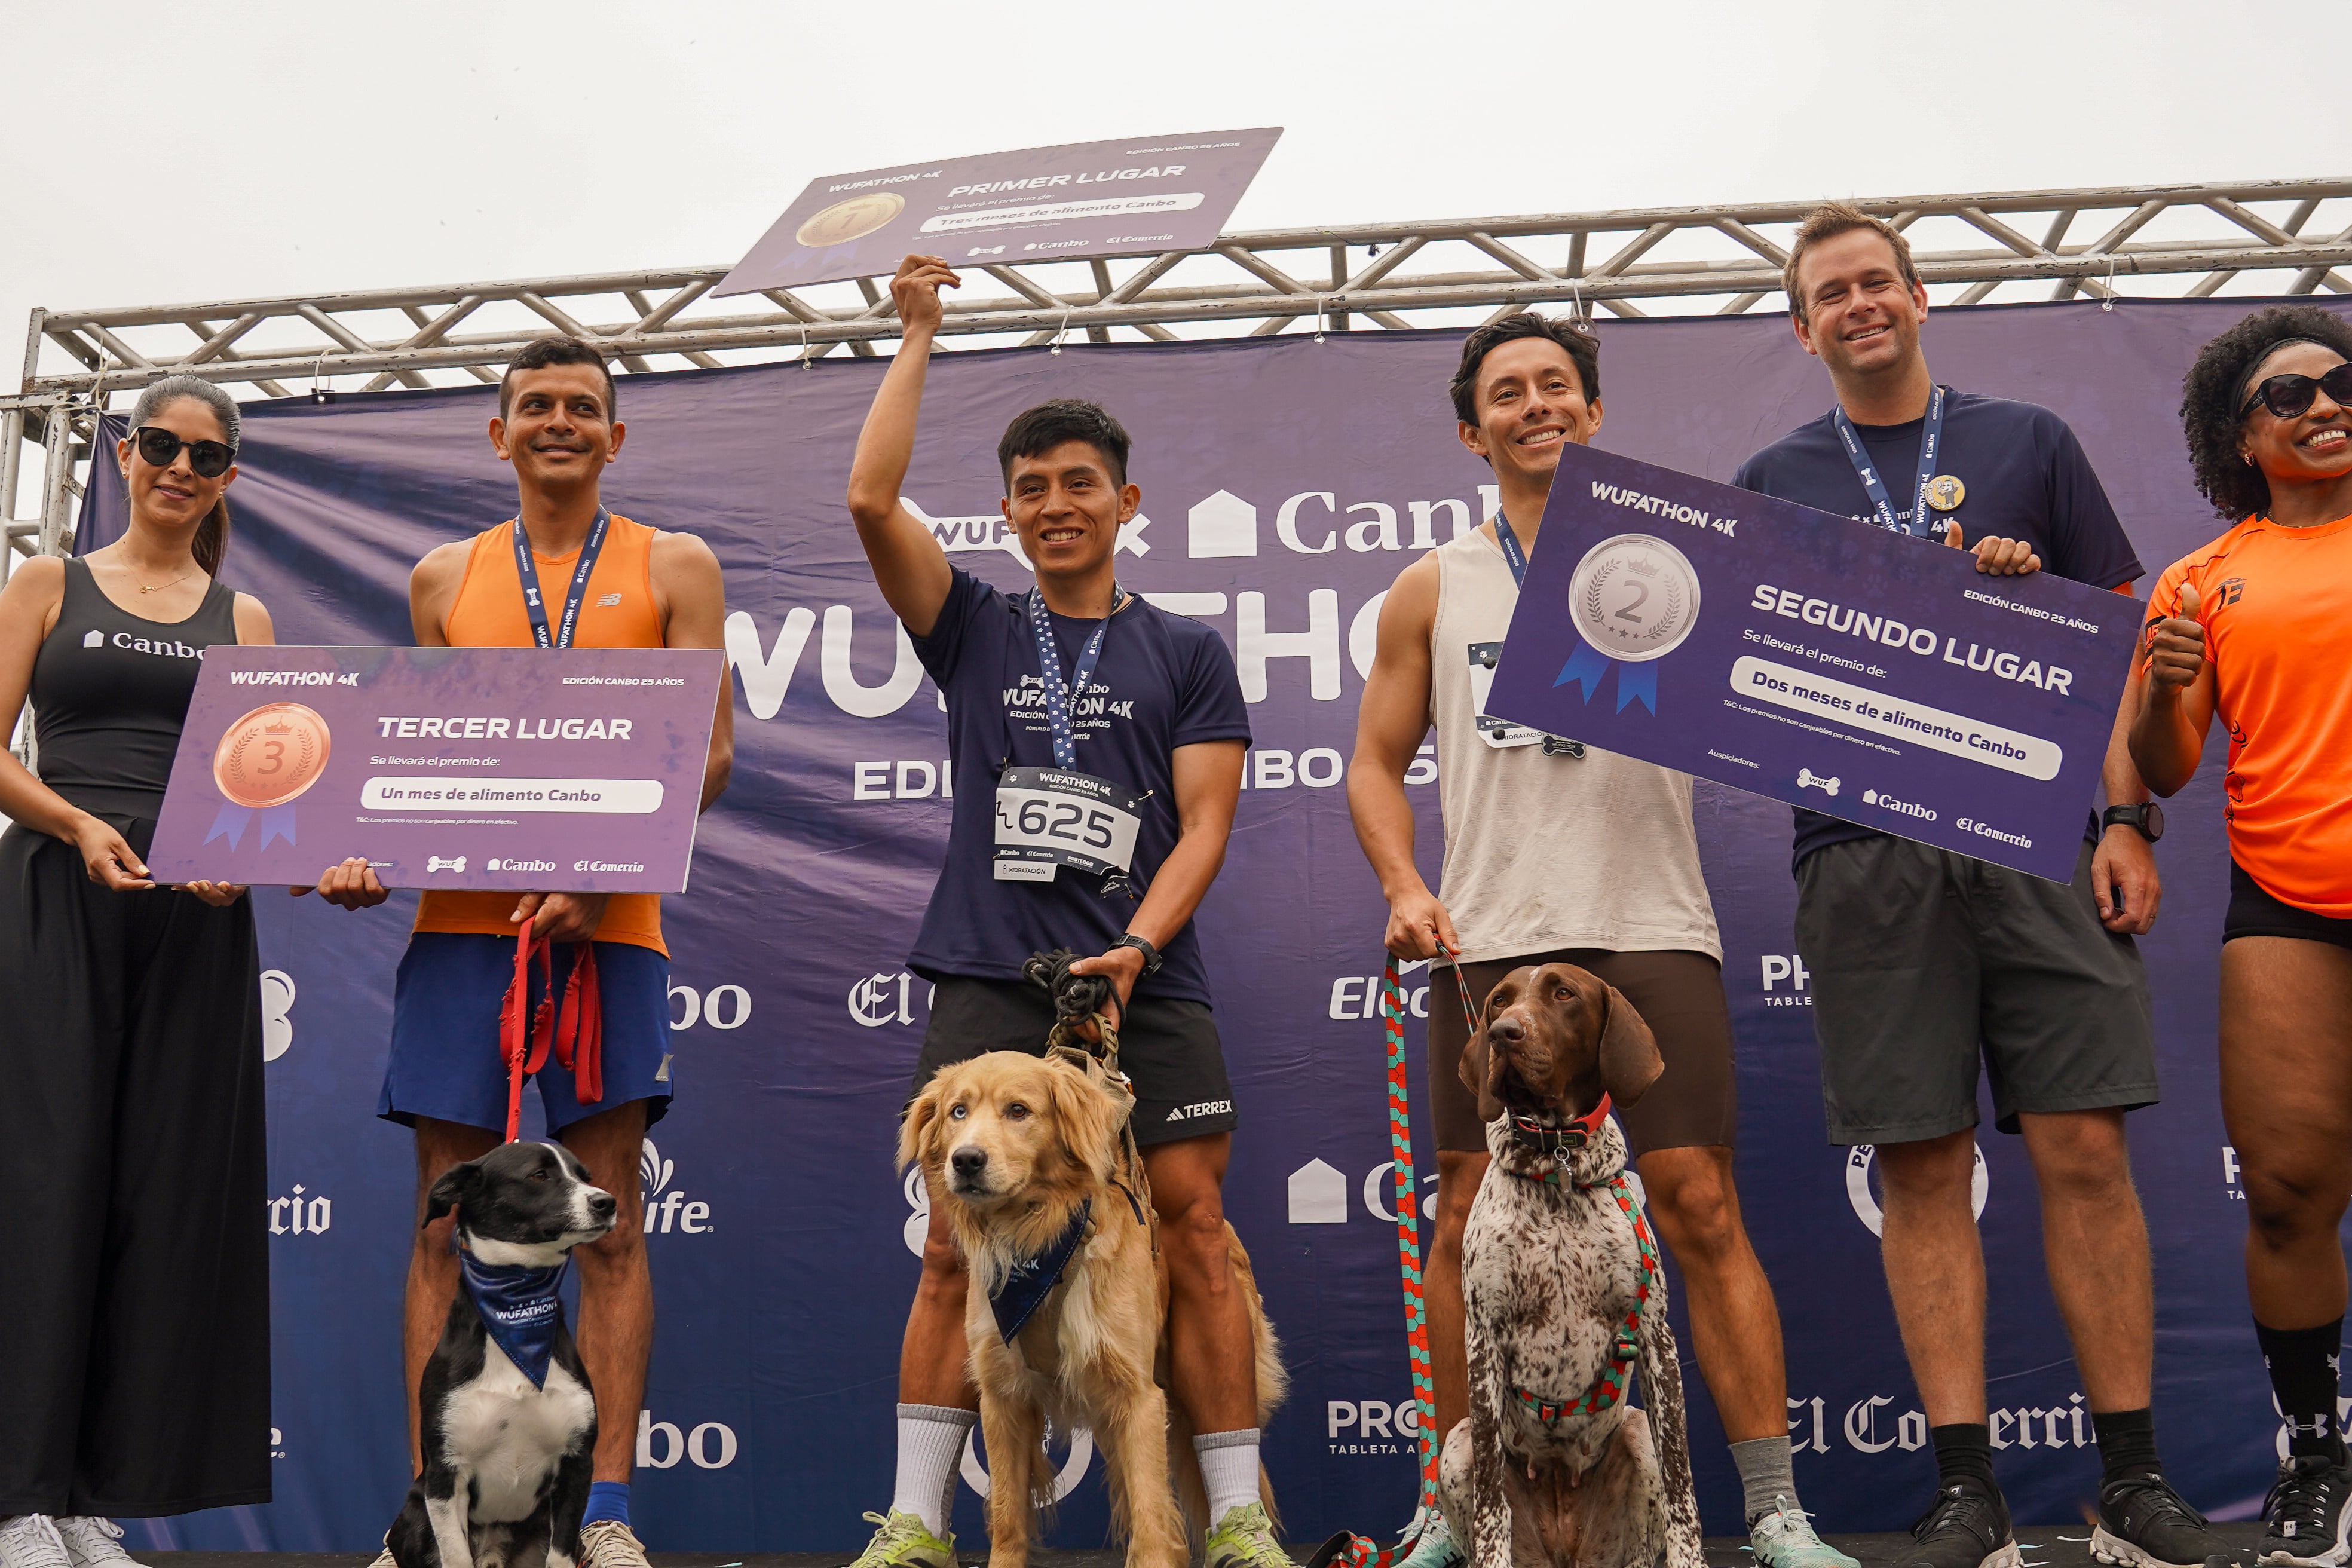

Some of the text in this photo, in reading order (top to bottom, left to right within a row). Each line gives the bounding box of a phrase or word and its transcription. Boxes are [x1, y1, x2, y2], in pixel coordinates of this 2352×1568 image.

[829, 173, 921, 192] WUFATHON
[947, 165, 1186, 198] PRIMER LUGAR
[941, 199, 1177, 226] Tres meses de alimento Canbo
[950, 200, 987, 210] llevará
[997, 196, 1036, 206] premio
[1037, 239, 1089, 250] Canbo
[1122, 234, 1174, 243] Comercio
[1927, 433, 1936, 454] Canbo
[1591, 480, 1739, 539] WUFATHON 4K
[1916, 480, 1930, 524] WUFATHON
[1276, 484, 1502, 554] Can
[1878, 500, 1898, 532] WUFATH
[578, 559, 590, 578] Canbo
[1615, 578, 1650, 625] 2
[1963, 589, 2099, 635] EDICIÓN CANBO 25 AÑOS
[537, 624, 549, 648] WUFA
[1090, 629, 1102, 649] Canbo
[1750, 584, 1938, 656] SEGUNDO
[1943, 637, 2072, 696] LUGAR
[1742, 629, 1887, 679] Se llevará el premio de:
[231, 671, 360, 687] WUFATHON 4K
[562, 676, 604, 685] EDICIÓN
[655, 676, 685, 686] AÑOS
[1003, 688, 1134, 720] WUFAON 4K
[1069, 669, 1090, 717] UFATHON 4K
[1010, 710, 1045, 719] EDICIÓN
[1086, 718, 1111, 728] AÑOS
[1751, 670, 2026, 762] Dos meses de alimento Canbo
[378, 717, 633, 740] TERCER LUGAR
[1723, 699, 1738, 709] T&C:
[1738, 704, 1751, 713] Los
[1751, 708, 1777, 720] premios
[1786, 718, 1799, 726] son
[1799, 721, 1833, 736] canjeables
[1832, 731, 1845, 740] por
[1844, 734, 1865, 746] dinero
[1874, 743, 1901, 755] efectivo.
[257, 740, 286, 775] 3
[370, 755, 500, 768] Se llevará el premio de:
[1707, 748, 1760, 770] Auspiciadores:
[1039, 773, 1111, 797] WUFATHON 4K
[1808, 776, 1829, 789] WUF
[381, 787, 601, 802] Un mes de alimento Canbo
[1878, 794, 1938, 822] Canbo
[1019, 798, 1114, 849] 625
[1956, 816, 2032, 849] El Comercio
[501, 859, 556, 872] Canbo
[574, 859, 644, 873] El Comercio
[1009, 866, 1046, 875] HIDRATACIÓN
[847, 971, 915, 1027] El
[1764, 996, 1812, 1006] TABLE
[1184, 1098, 1233, 1119] TERREX
[495, 1303, 555, 1320] WUFATHON
[1844, 1392, 2098, 1454] Coerci
[1328, 1444, 1398, 1454] TABLETA
